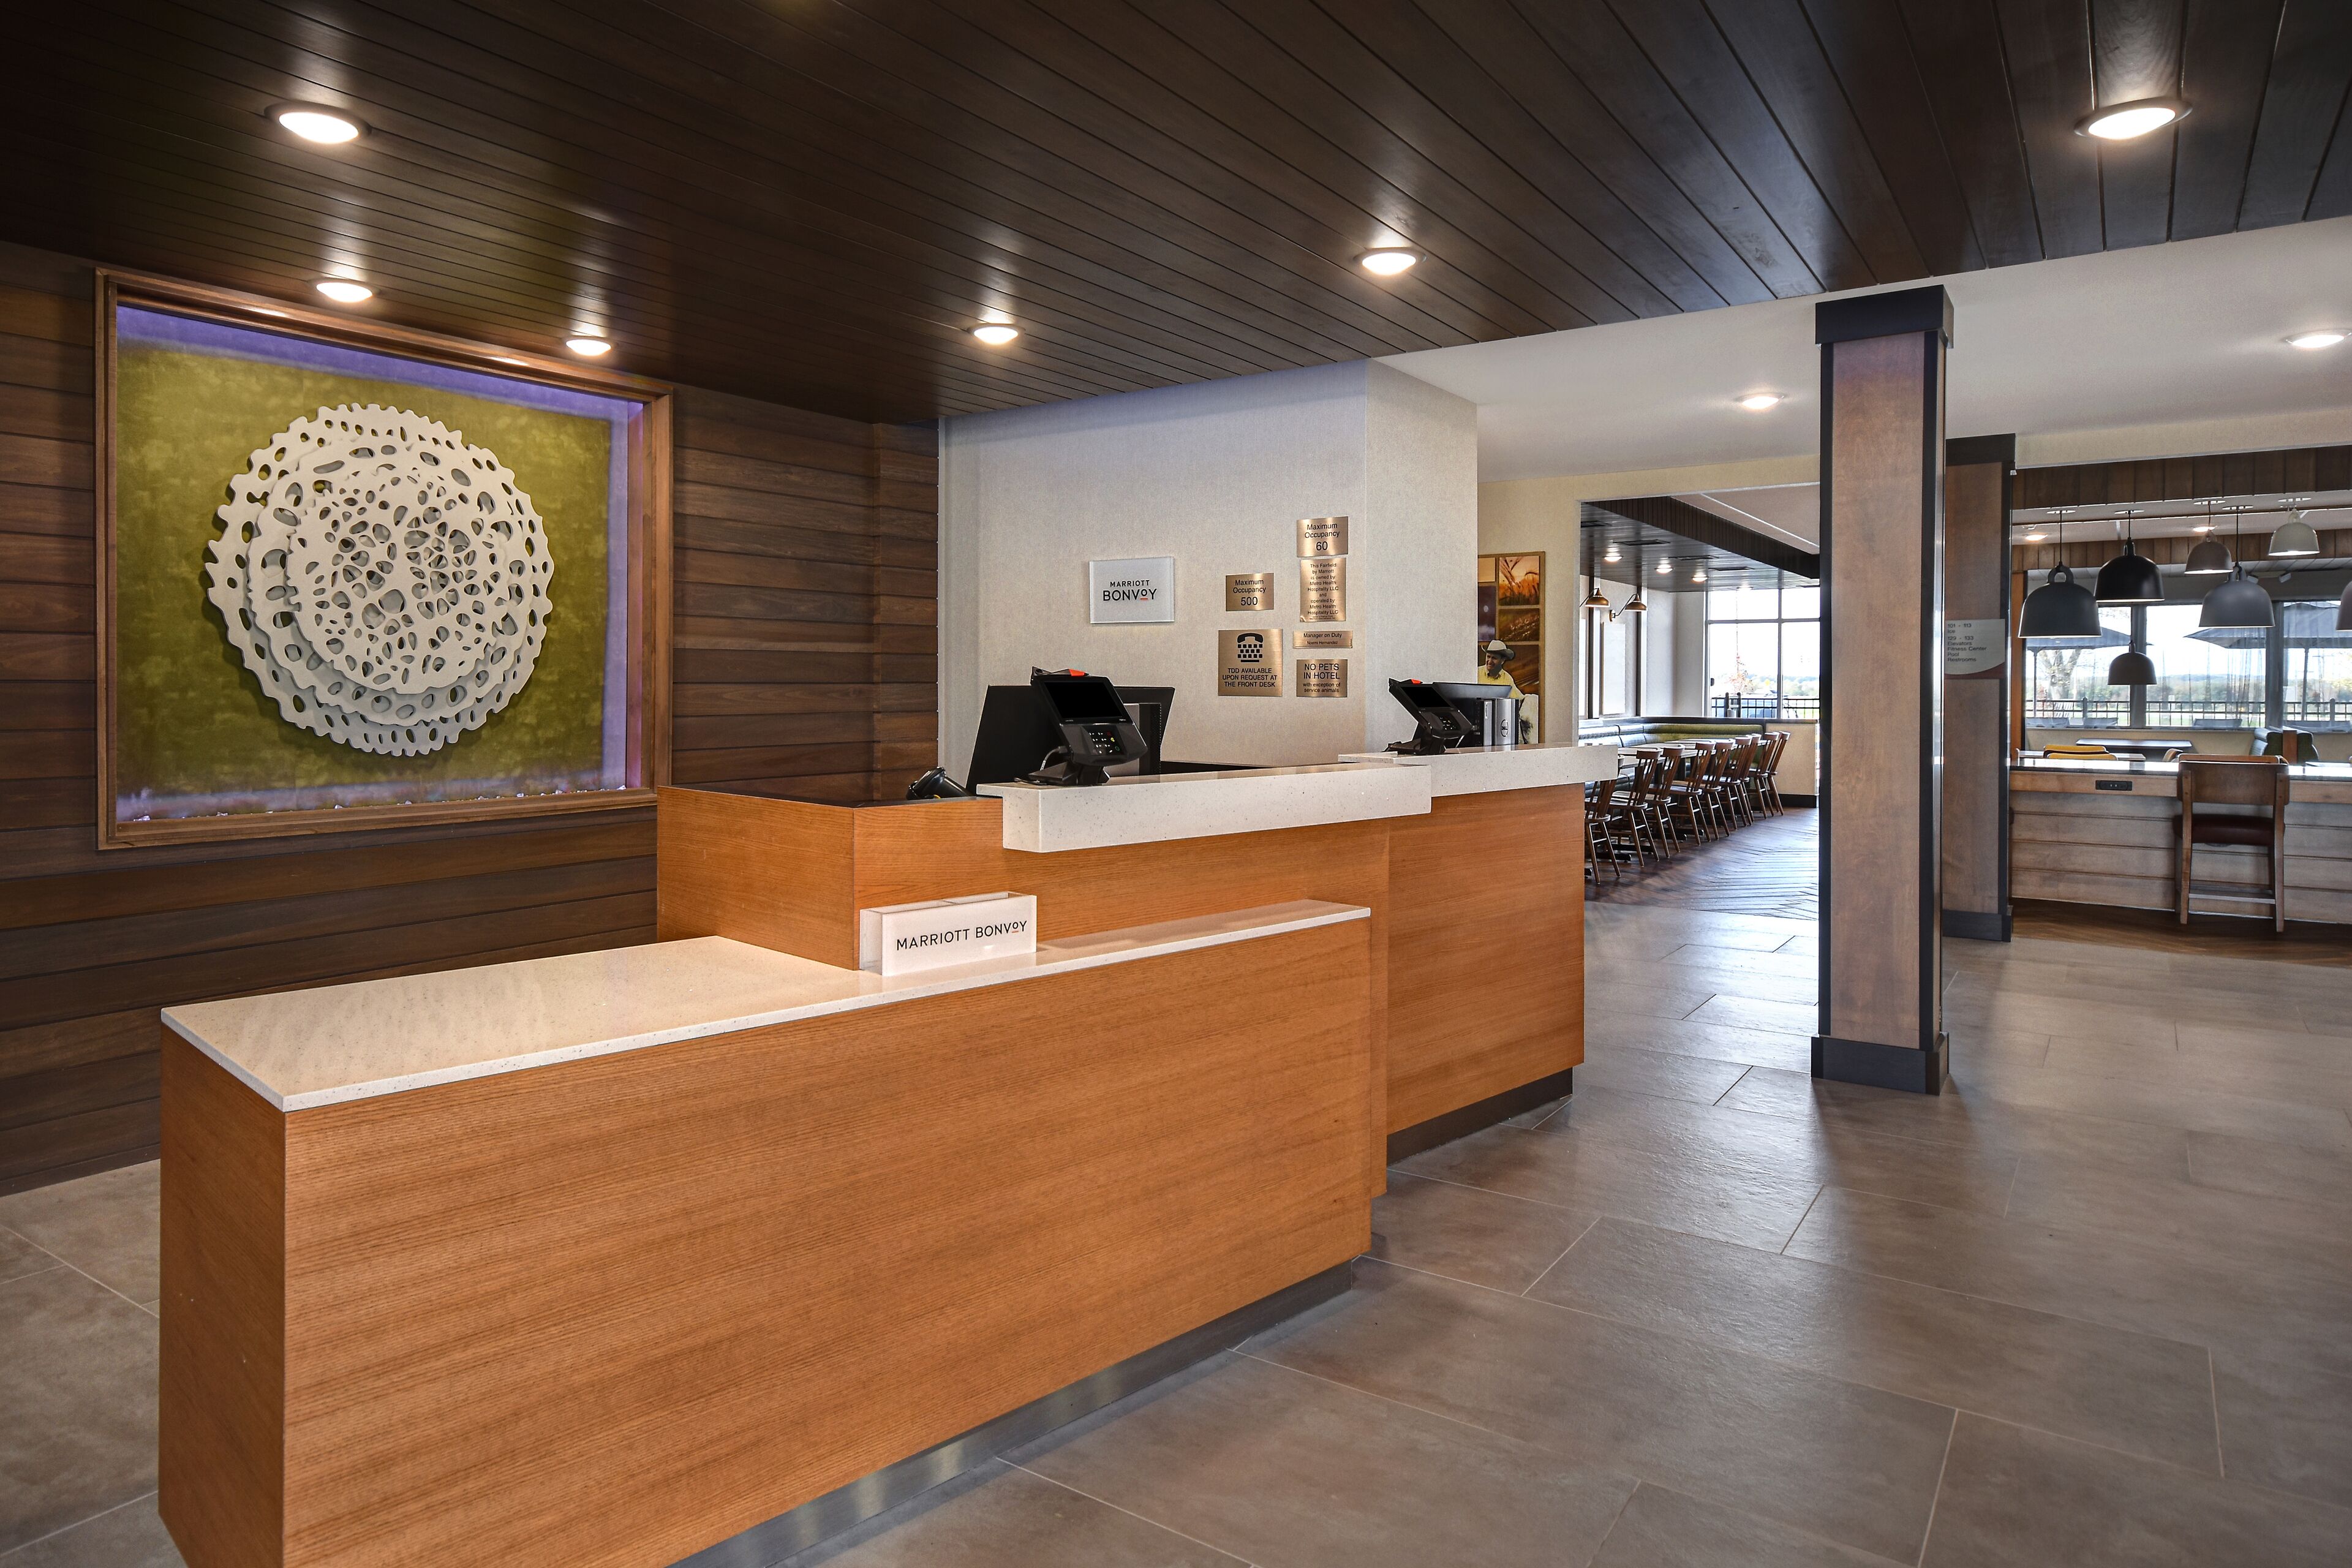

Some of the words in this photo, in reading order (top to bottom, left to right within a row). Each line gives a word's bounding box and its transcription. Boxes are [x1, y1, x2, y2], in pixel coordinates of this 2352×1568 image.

[1316, 541, 1328, 551] 60
[1103, 589, 1157, 601] BONVOY
[1241, 597, 1258, 606] 500
[896, 929, 970, 951] MARRIOTT
[975, 921, 1027, 938] BONVOY
